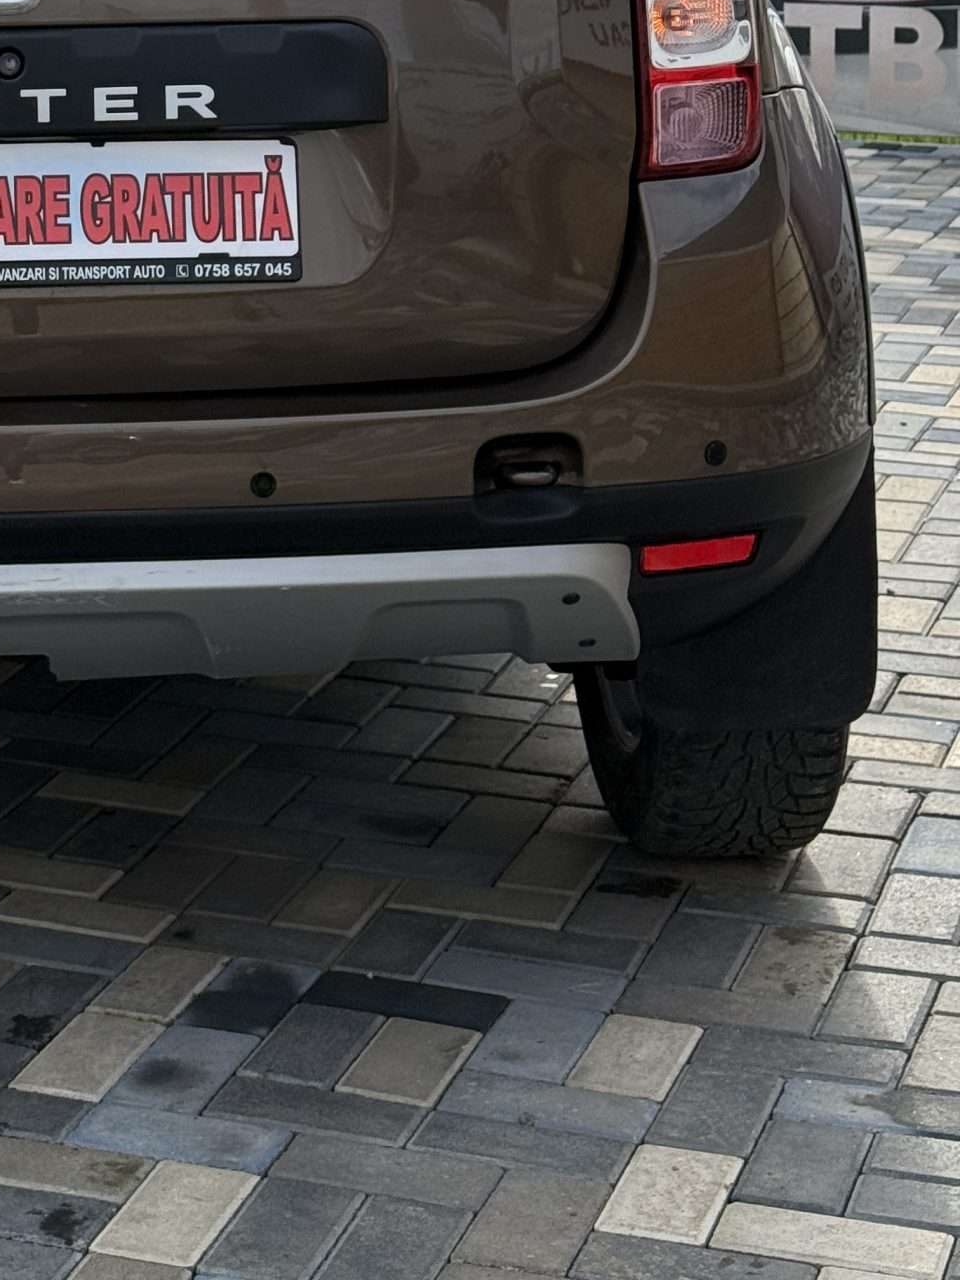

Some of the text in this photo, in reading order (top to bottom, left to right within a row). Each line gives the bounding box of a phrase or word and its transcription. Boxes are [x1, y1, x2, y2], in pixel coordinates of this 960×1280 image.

[80, 154, 294, 245] GRATUITĂ
[48, 266, 60, 280] SI
[61, 265, 132, 280] TRANSPORT
[133, 264, 166, 278] AUTO
[194, 263, 231, 278] 0758
[234, 263, 260, 277] 657
[265, 262, 292, 276] 045
